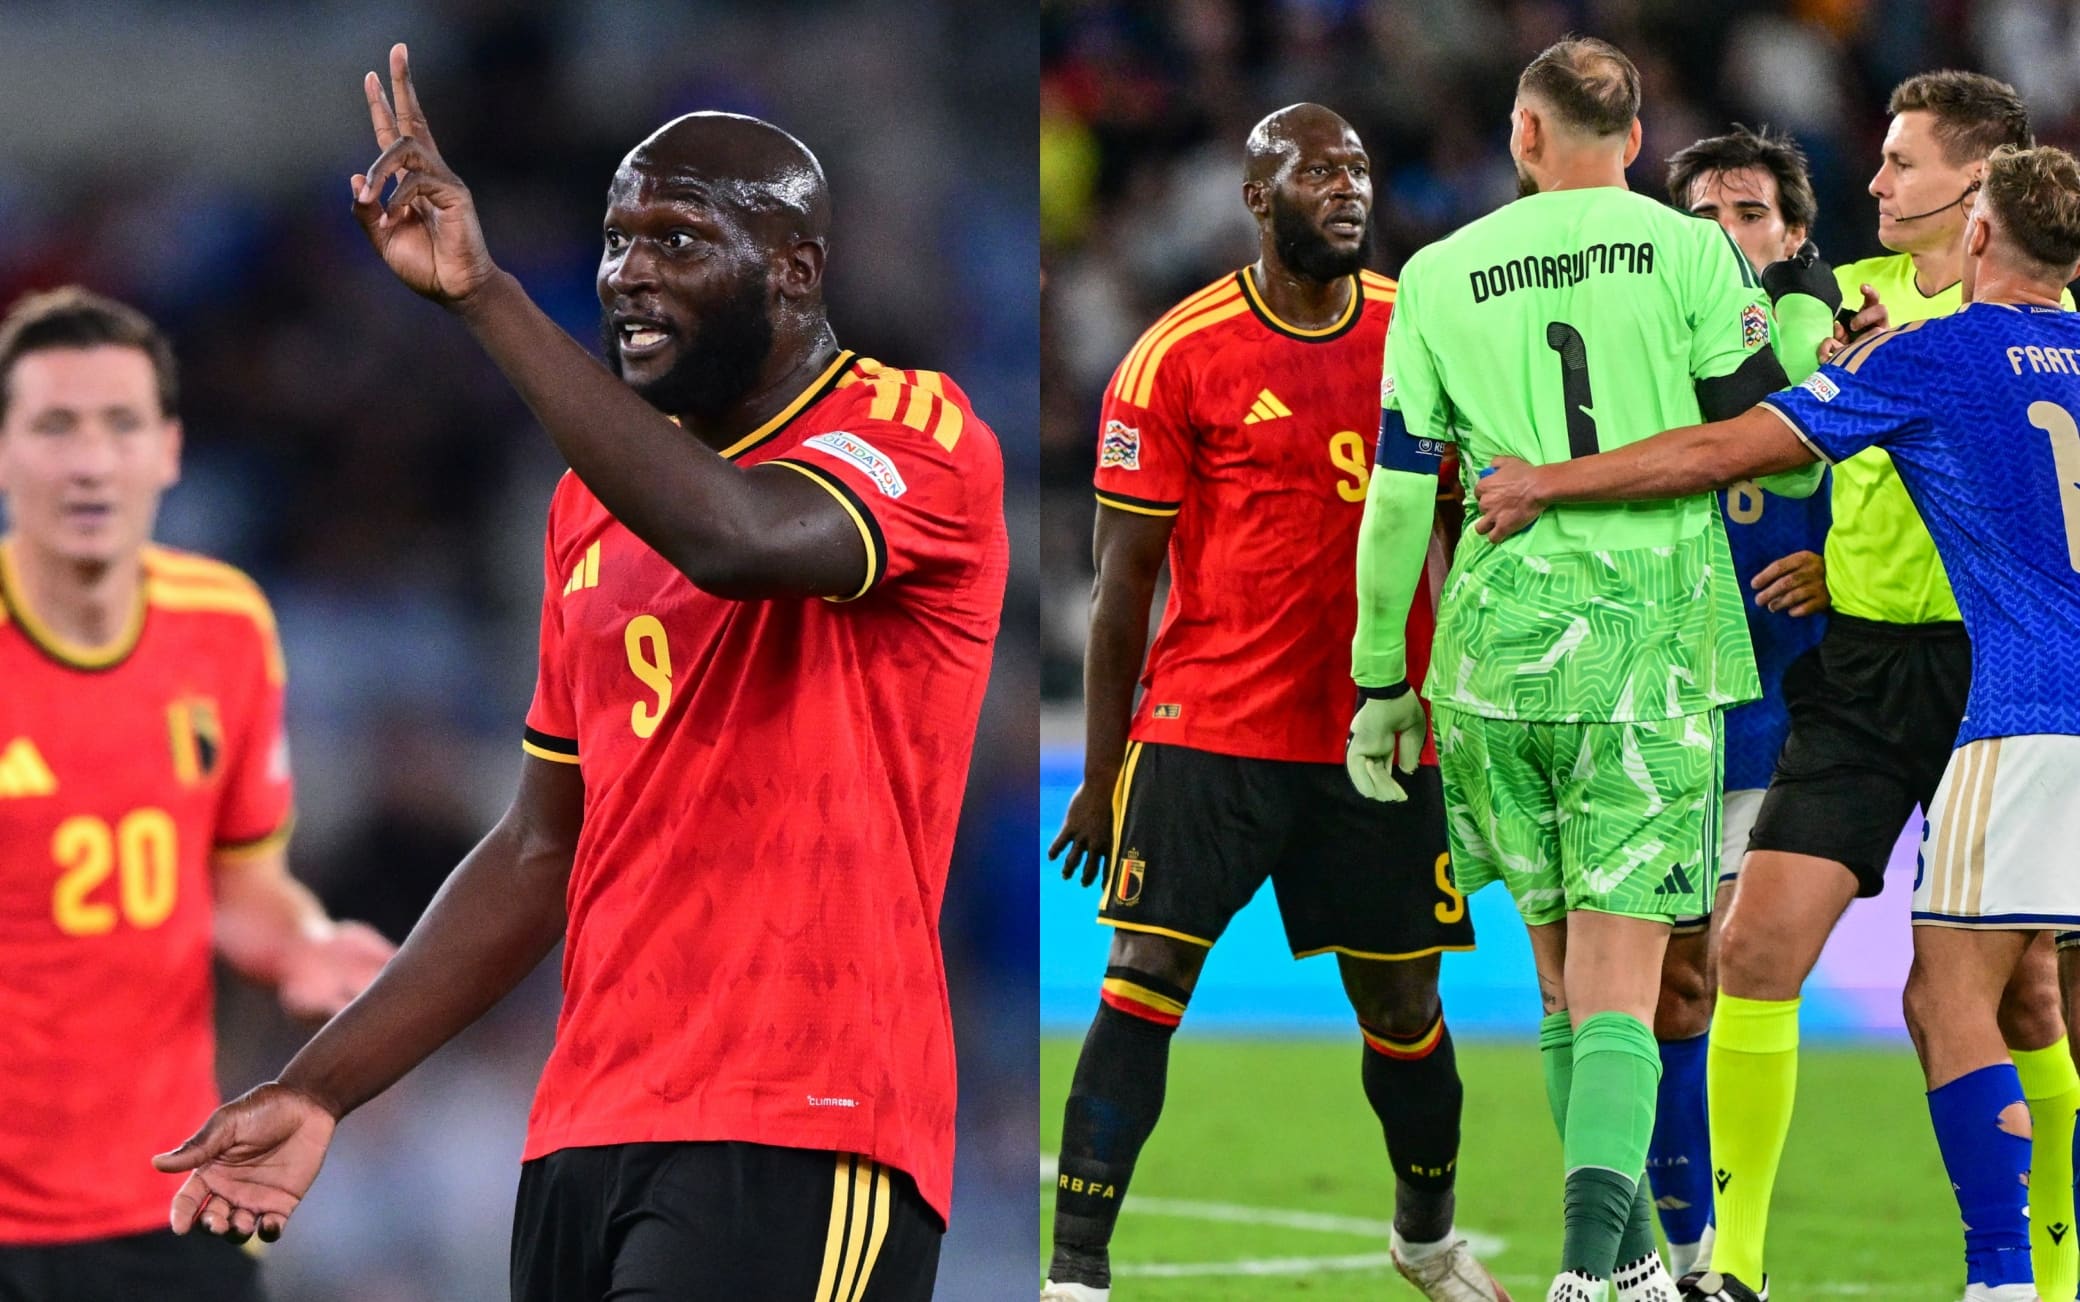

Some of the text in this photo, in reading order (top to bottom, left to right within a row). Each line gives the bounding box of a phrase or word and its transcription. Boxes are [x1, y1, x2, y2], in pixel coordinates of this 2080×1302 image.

[1469, 242, 1654, 304] DONNARUMMA
[1546, 321, 1600, 459] 1
[2006, 345, 2080, 376] FRAT
[1329, 430, 1370, 503] 9
[624, 614, 673, 739] 9
[52, 809, 177, 936] 20
[1059, 1174, 1114, 1199] RBFA
